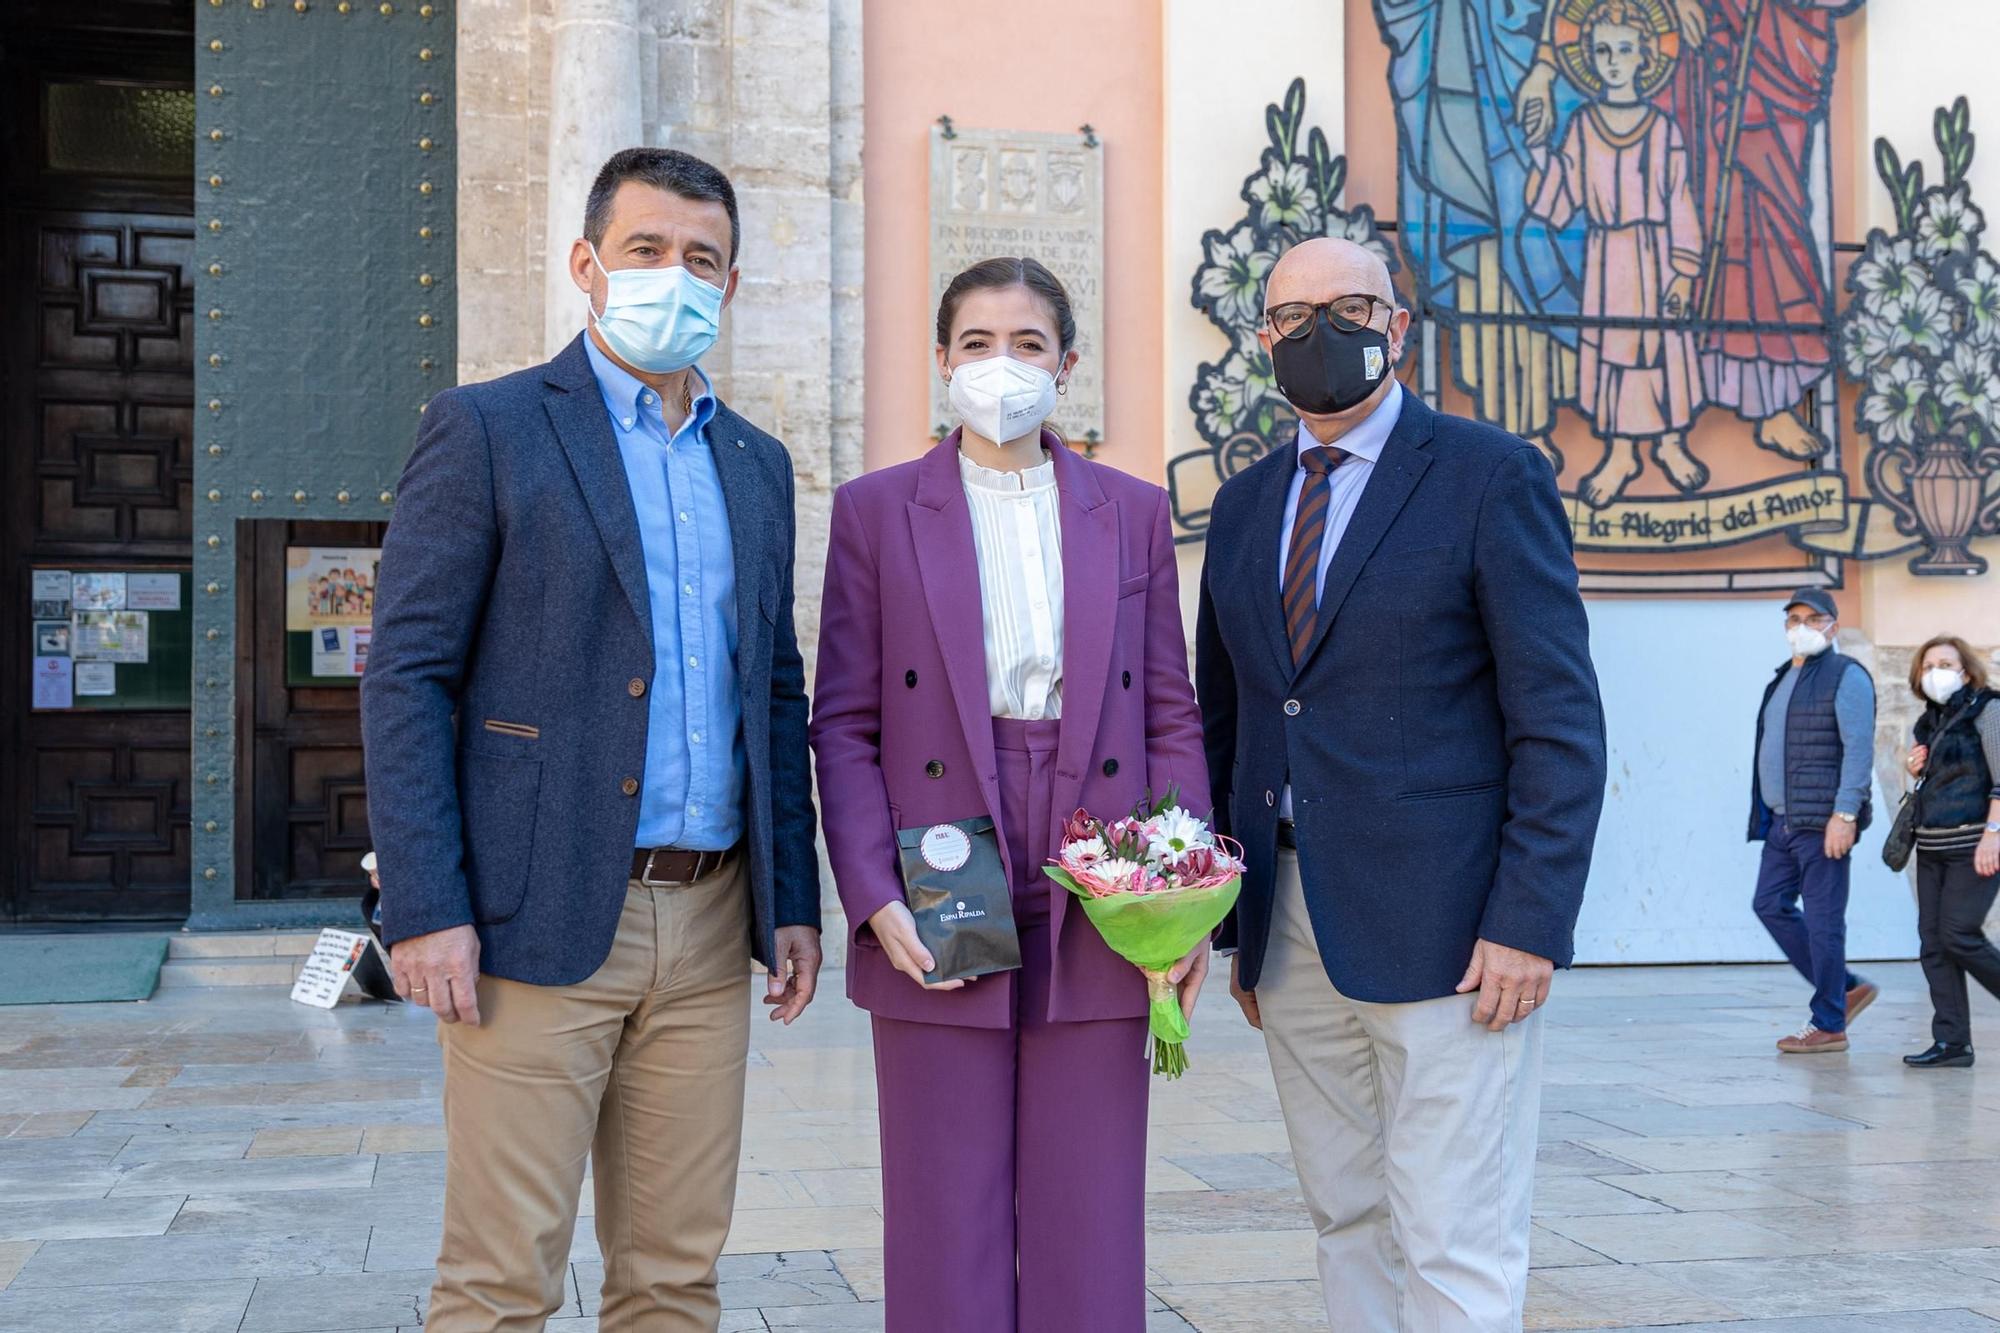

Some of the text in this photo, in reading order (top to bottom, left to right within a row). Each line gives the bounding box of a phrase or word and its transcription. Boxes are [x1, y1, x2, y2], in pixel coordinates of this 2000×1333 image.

[939, 224, 960, 238] EN
[963, 242, 1036, 258] VALENCIA
[1041, 246, 1061, 258] DE
[1588, 510, 1610, 537] la
[1621, 511, 1711, 543] Alegria
[1722, 500, 1757, 532] del
[1764, 487, 1836, 521] Amor
